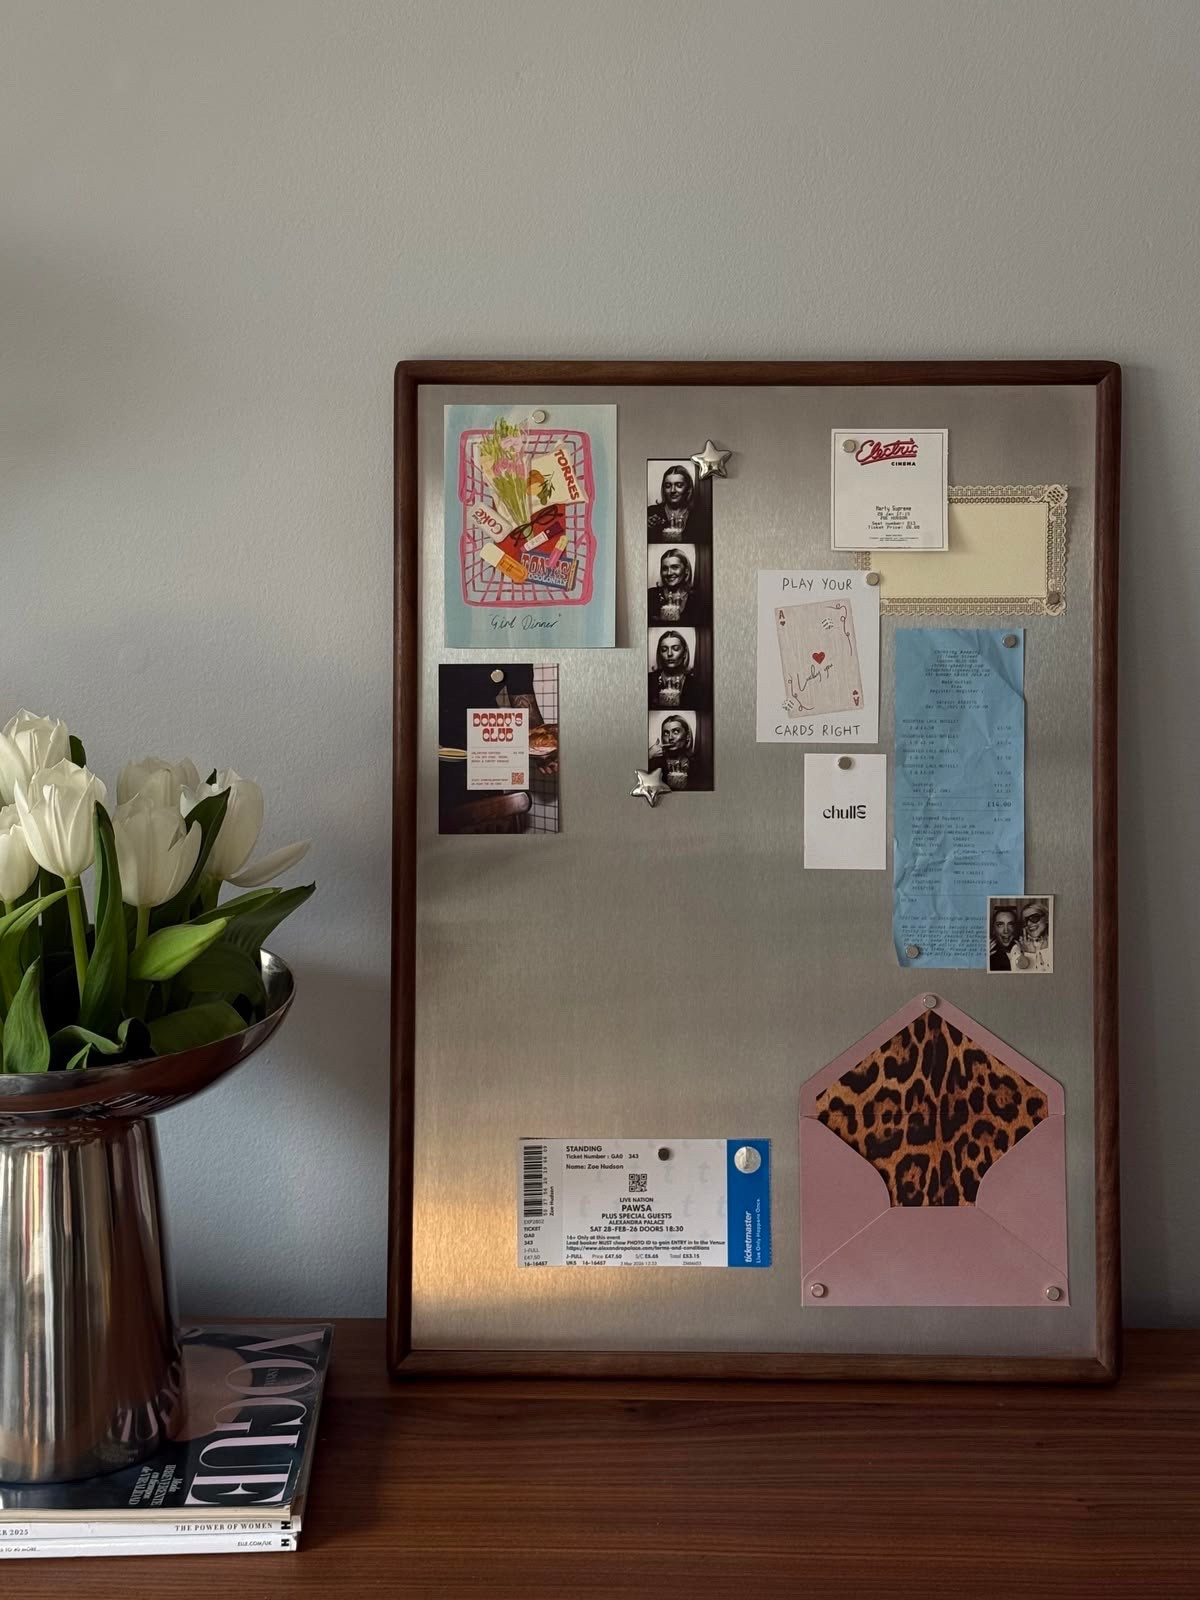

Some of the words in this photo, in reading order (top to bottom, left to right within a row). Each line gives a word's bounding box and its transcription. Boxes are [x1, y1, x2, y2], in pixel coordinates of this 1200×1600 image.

[855, 438, 918, 464] Electric
[553, 449, 580, 501] TORRES
[892, 504, 912, 512] Supreme
[474, 508, 504, 535] Coke
[782, 577, 814, 591] PLAY
[821, 577, 853, 591] YOUR
[778, 609, 785, 619] A
[774, 724, 814, 736] CARDS
[822, 724, 861, 736] RIGHT
[621, 1204, 653, 1212] PAWSA
[744, 1211, 752, 1263] ticketmaster
[184, 1327, 327, 1506] VOGUE
[240, 1522, 273, 1530] WOMEN
